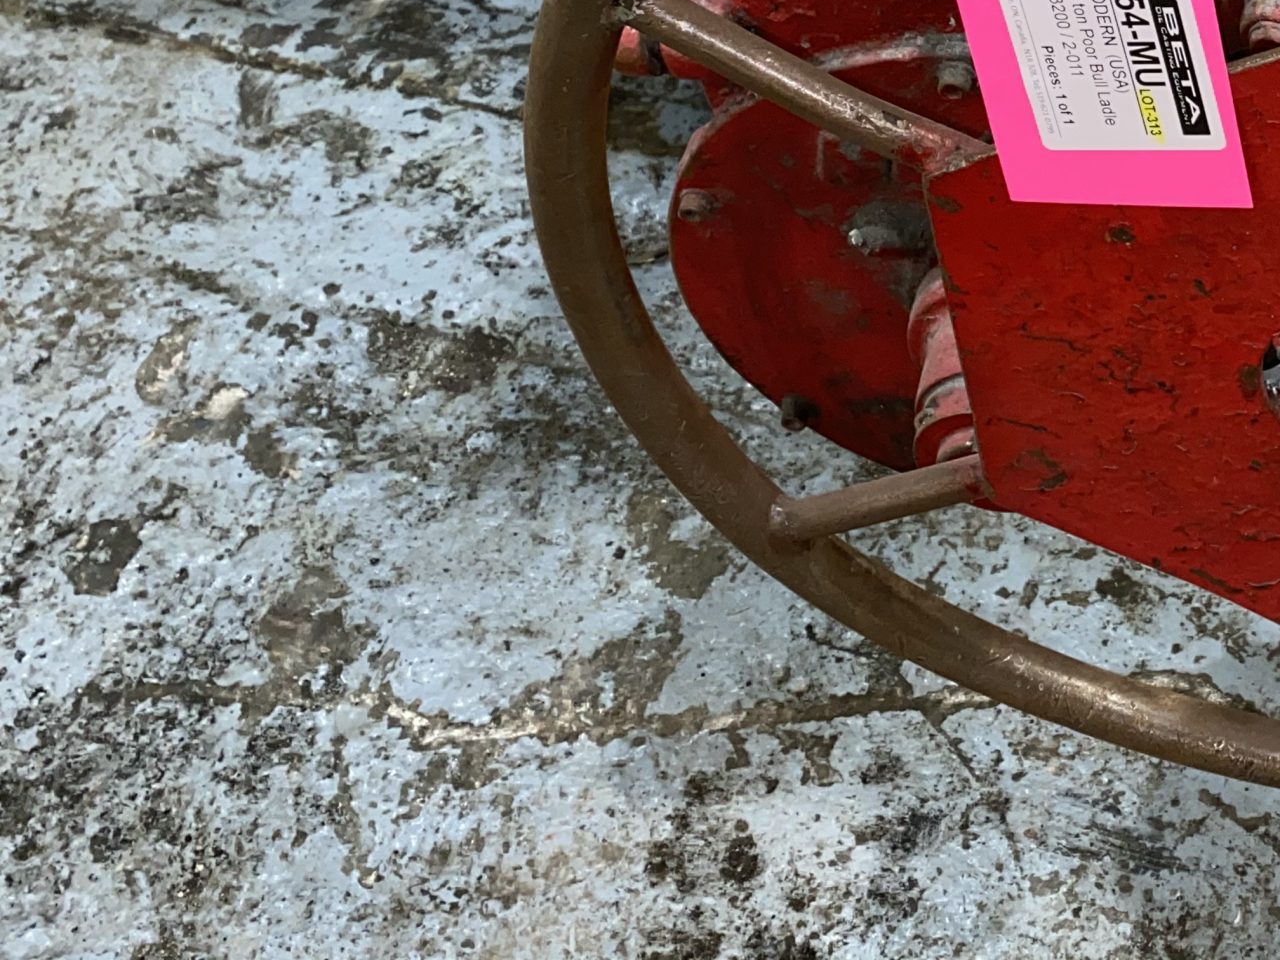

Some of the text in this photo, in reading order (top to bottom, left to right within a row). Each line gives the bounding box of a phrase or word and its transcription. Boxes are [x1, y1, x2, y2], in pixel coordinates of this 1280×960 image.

[1072, 3, 1087, 23] ton
[1061, 41, 1084, 75] 2-011
[1079, 28, 1097, 59] Poor
[1041, 45, 1061, 88] Pieces:
[1058, 103, 1072, 115] of
[1089, 63, 1108, 87] Bull
[1105, 54, 1128, 92] (USA)
[1162, 6, 1200, 123] BETA
[1097, 91, 1116, 125] Ladle
[1139, 88, 1161, 135] LOT-313
